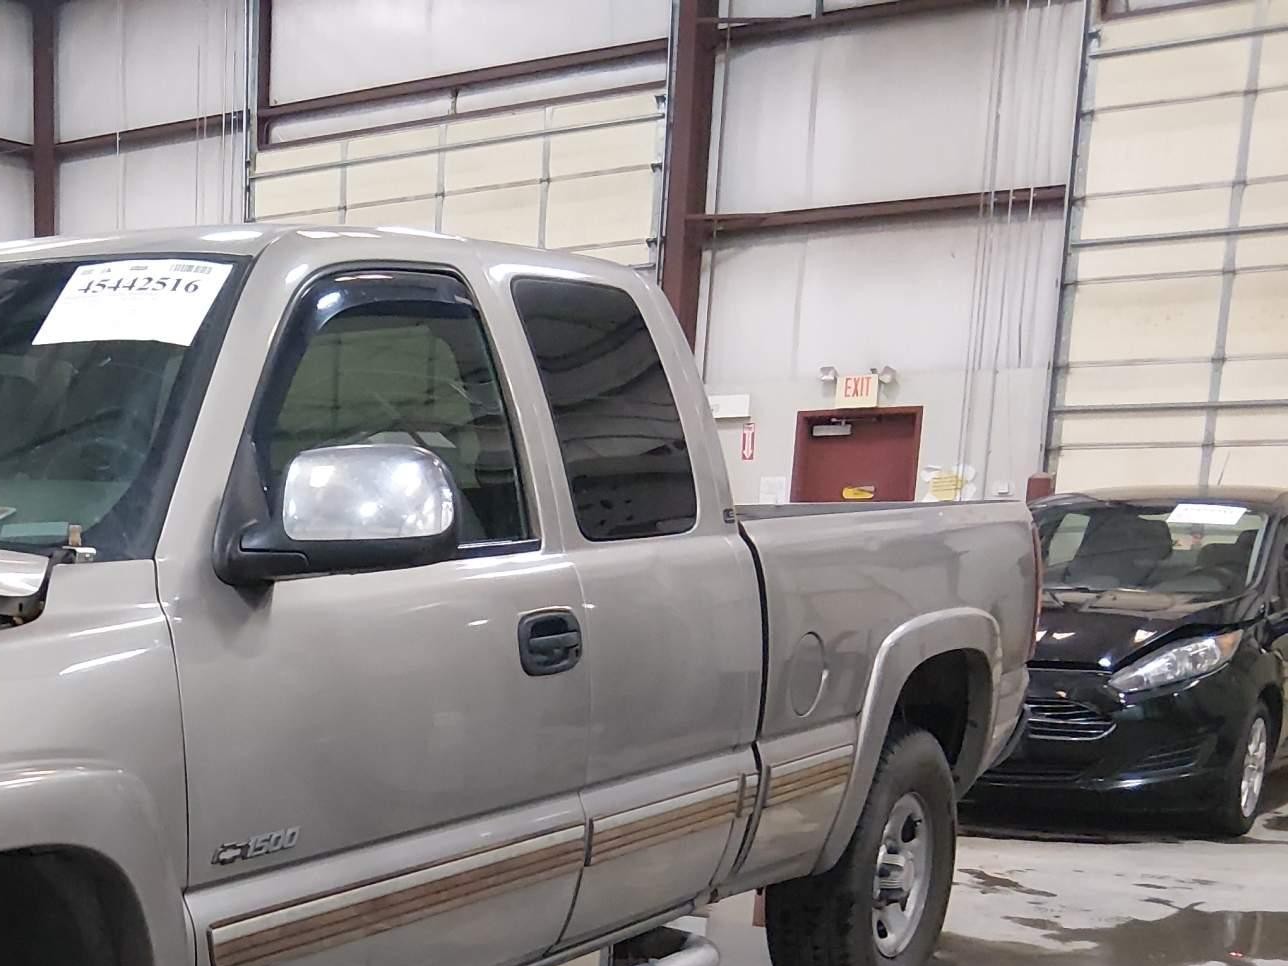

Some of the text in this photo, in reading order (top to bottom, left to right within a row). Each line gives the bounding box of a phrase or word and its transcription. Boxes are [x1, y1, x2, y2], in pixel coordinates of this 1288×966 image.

[78, 277, 200, 293] 45442516
[845, 377, 872, 397] EXIT
[248, 827, 300, 857] 1500
